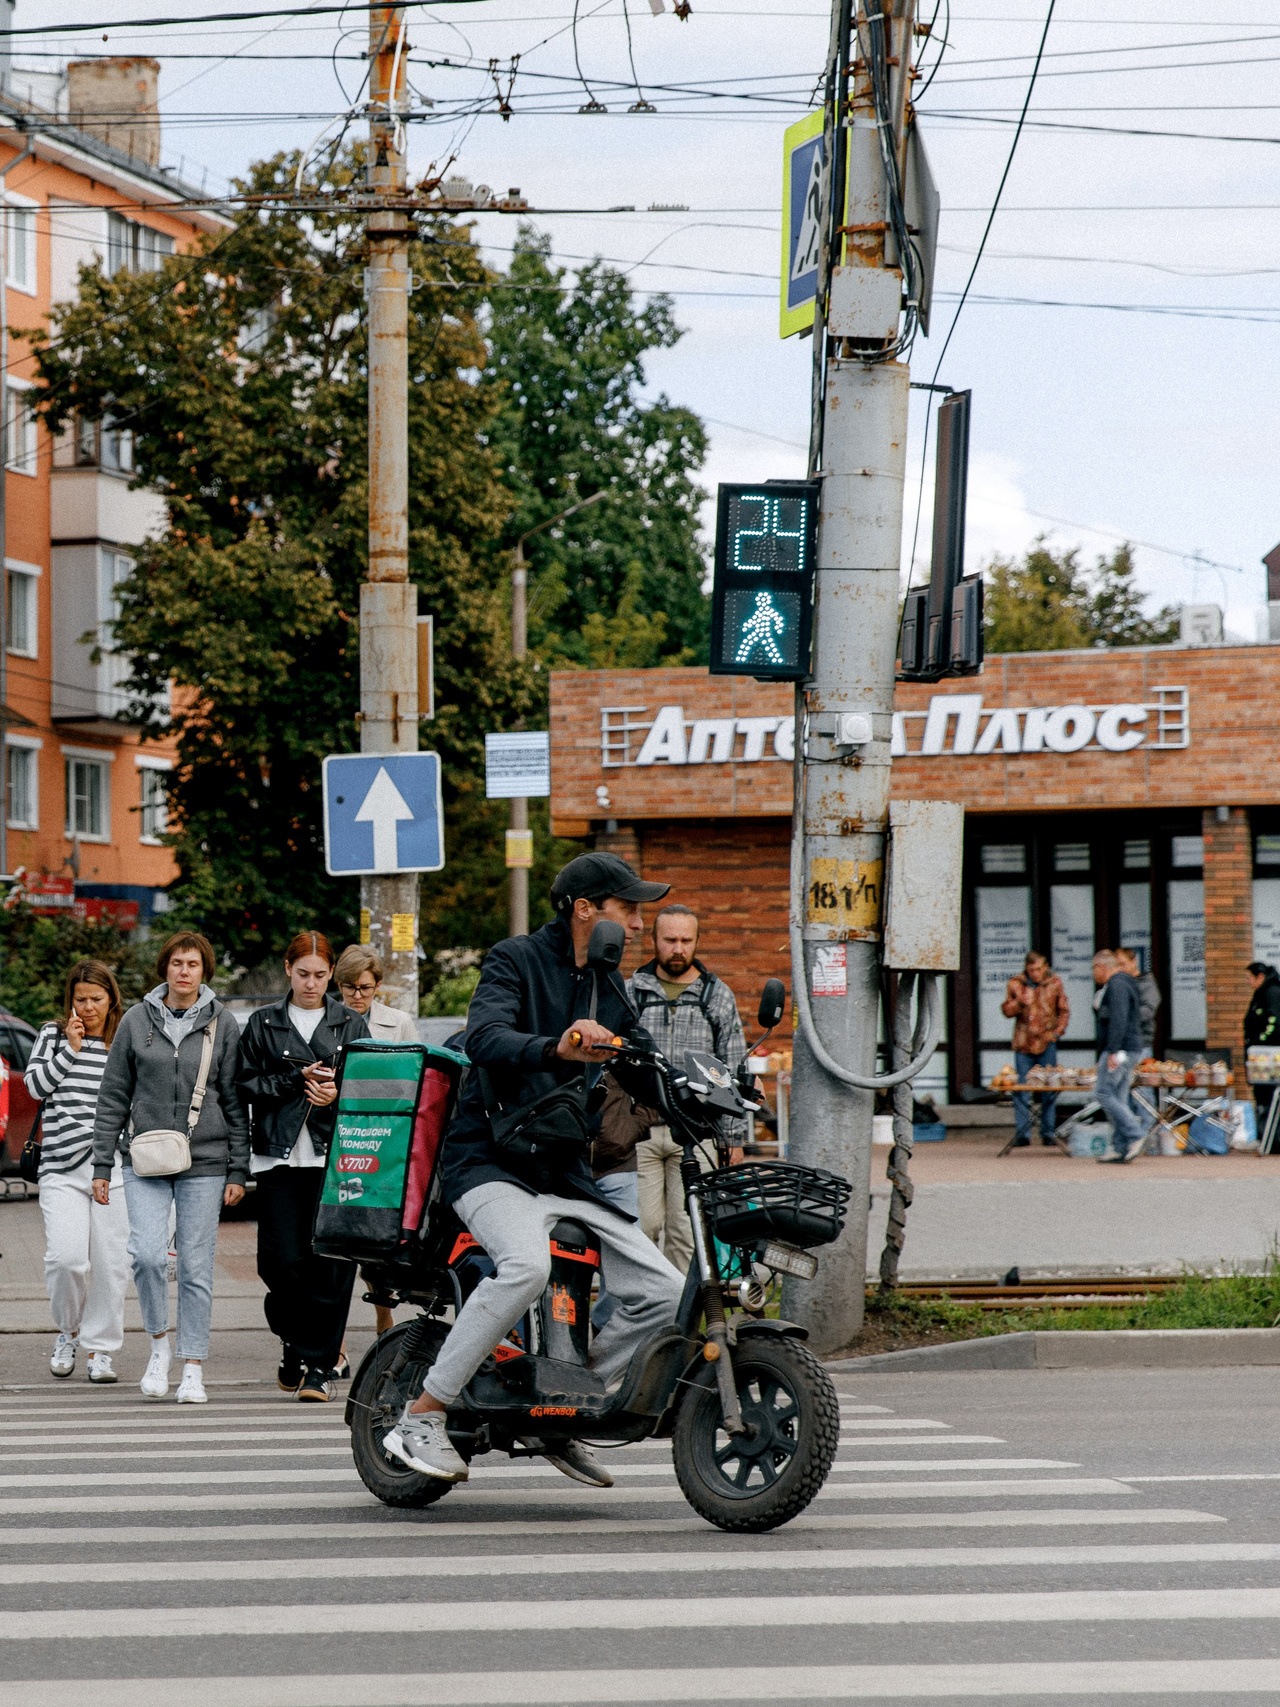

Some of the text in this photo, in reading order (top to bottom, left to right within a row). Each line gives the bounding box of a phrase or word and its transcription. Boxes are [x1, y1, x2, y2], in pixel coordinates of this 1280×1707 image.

[733, 494, 806, 571] 24
[636, 694, 1148, 764] Апте Плюс
[341, 1139, 383, 1152] команду
[543, 1406, 579, 1417] WENBOX
